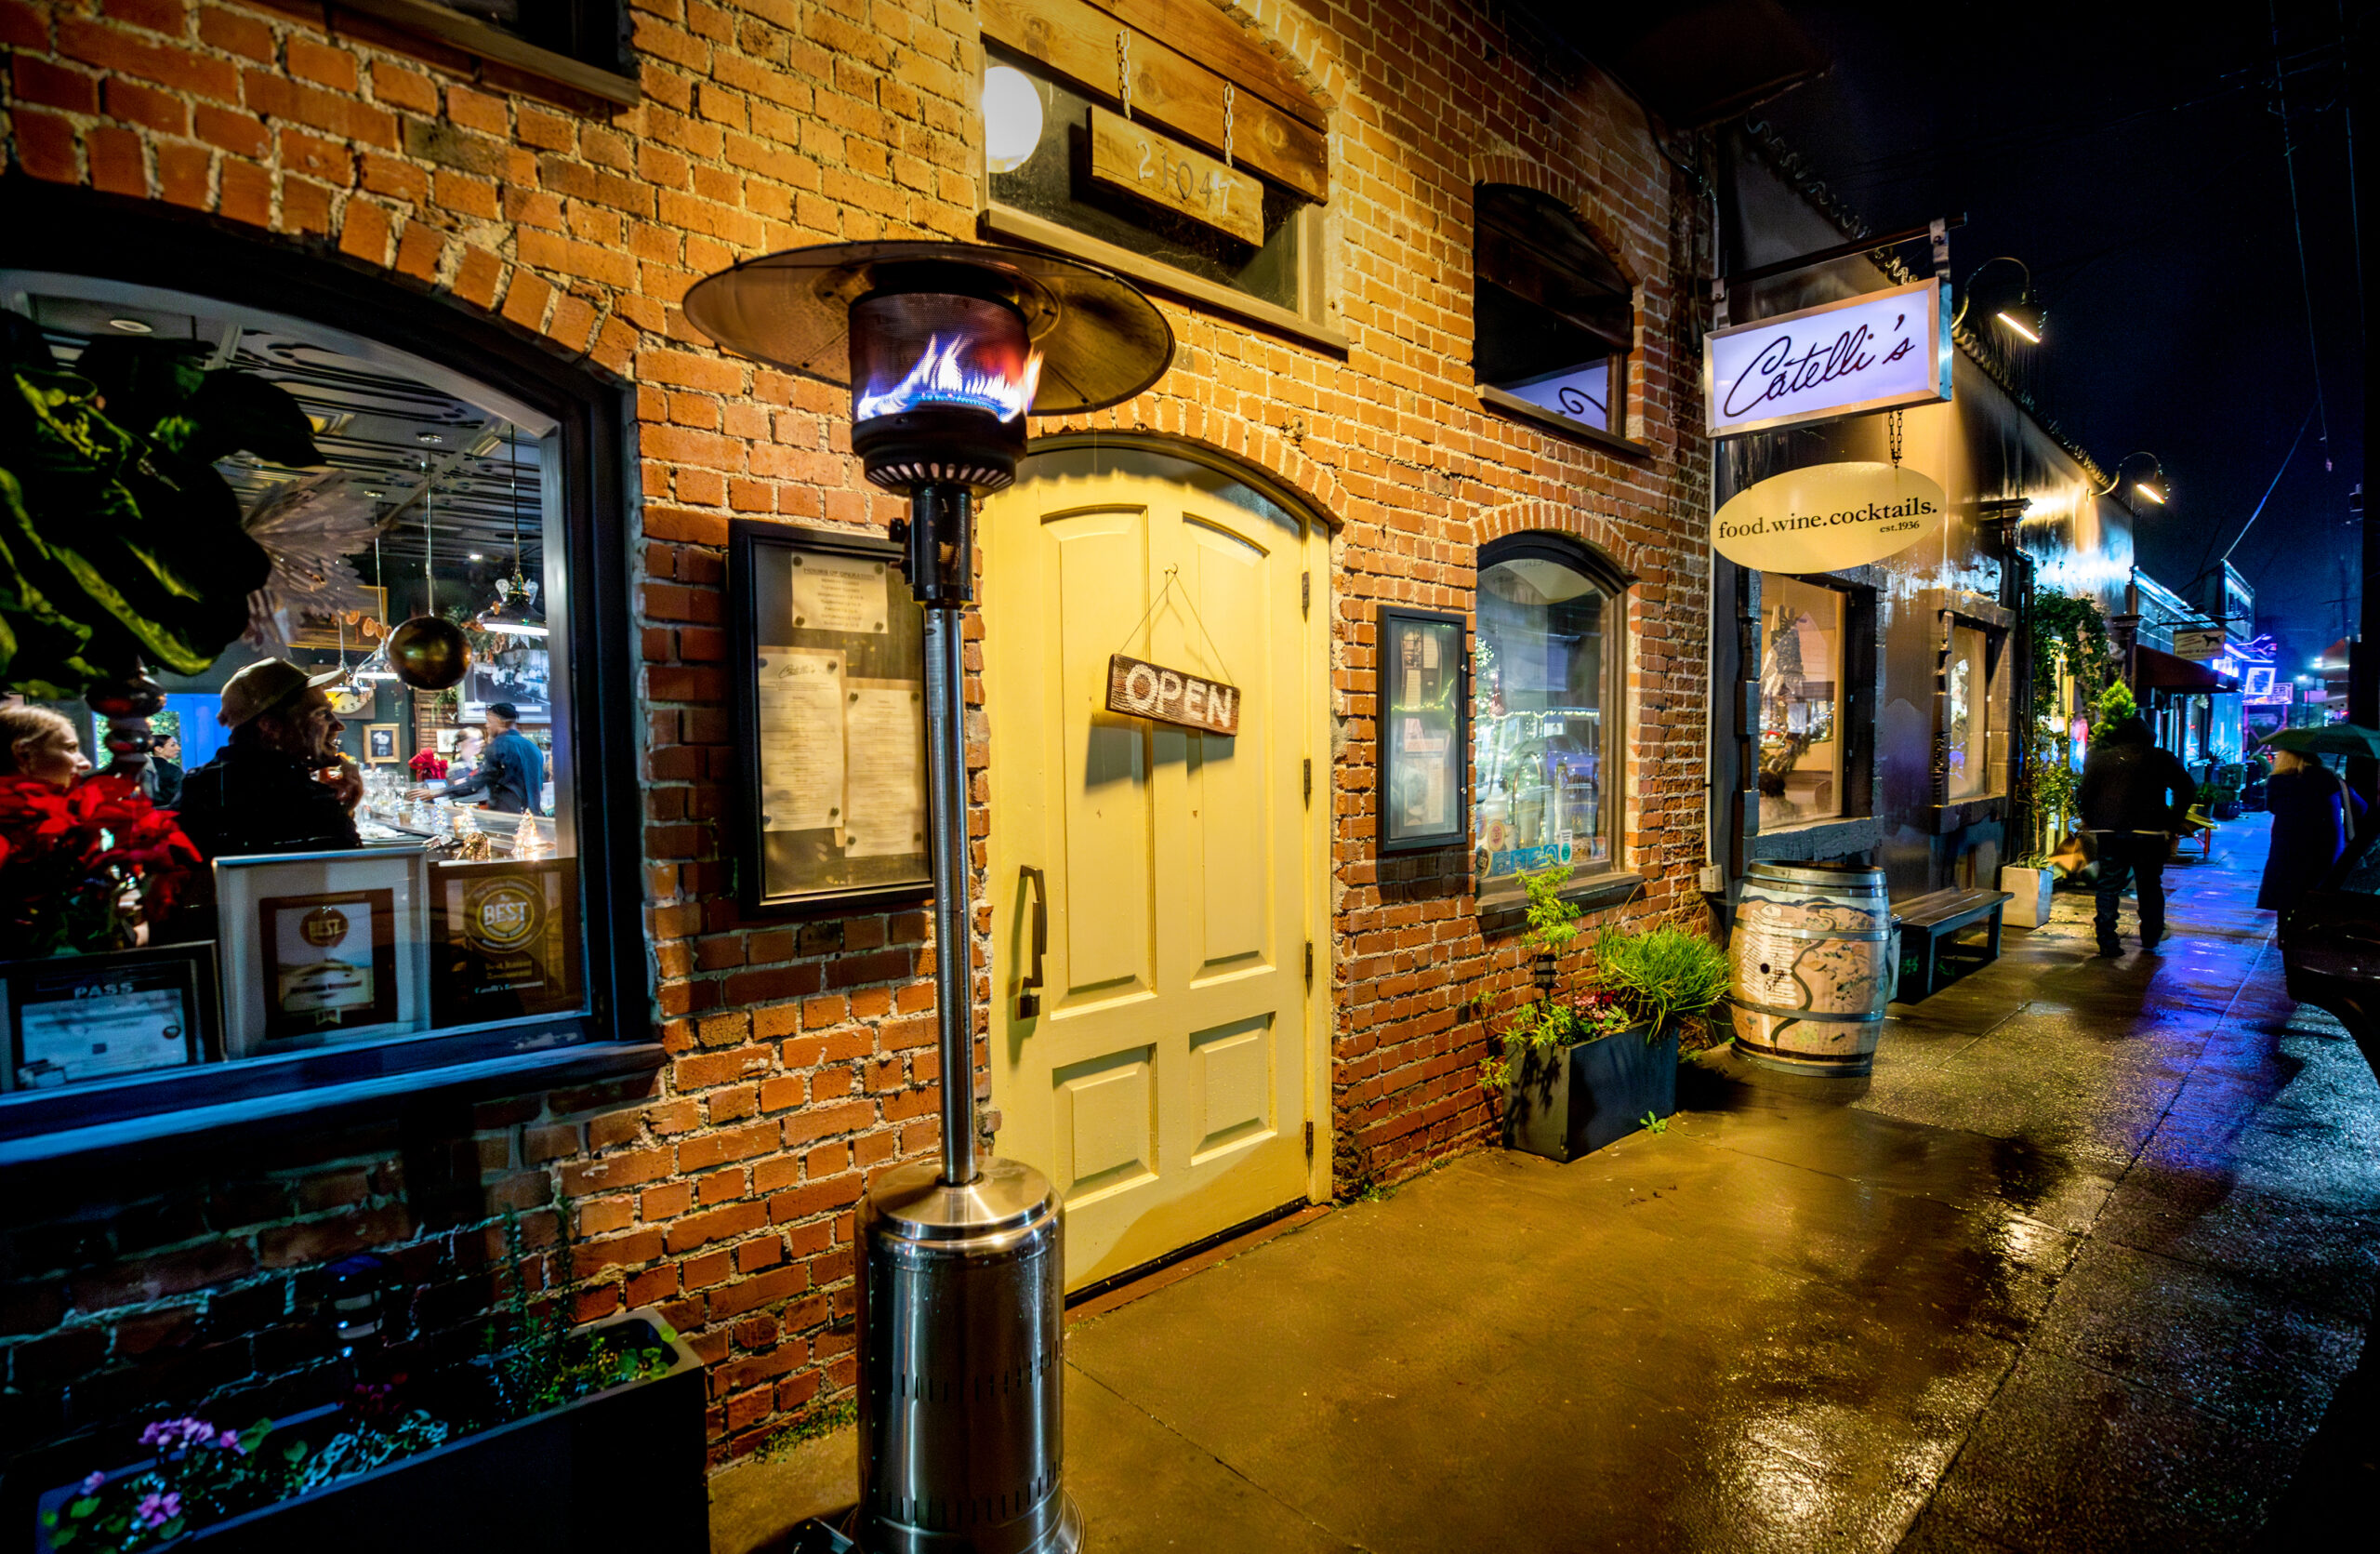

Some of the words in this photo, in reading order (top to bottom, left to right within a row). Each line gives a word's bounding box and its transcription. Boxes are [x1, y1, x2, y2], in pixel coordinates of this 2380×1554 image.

[1136, 140, 1232, 218] 21047
[1724, 313, 1915, 418] Catelli's
[1718, 498, 1937, 538] food.wine.cocktails.
[1880, 520, 1920, 534] est.1936
[1125, 663, 1233, 728] OPEN
[483, 902, 527, 926] BEST
[74, 982, 134, 1000] PASS
